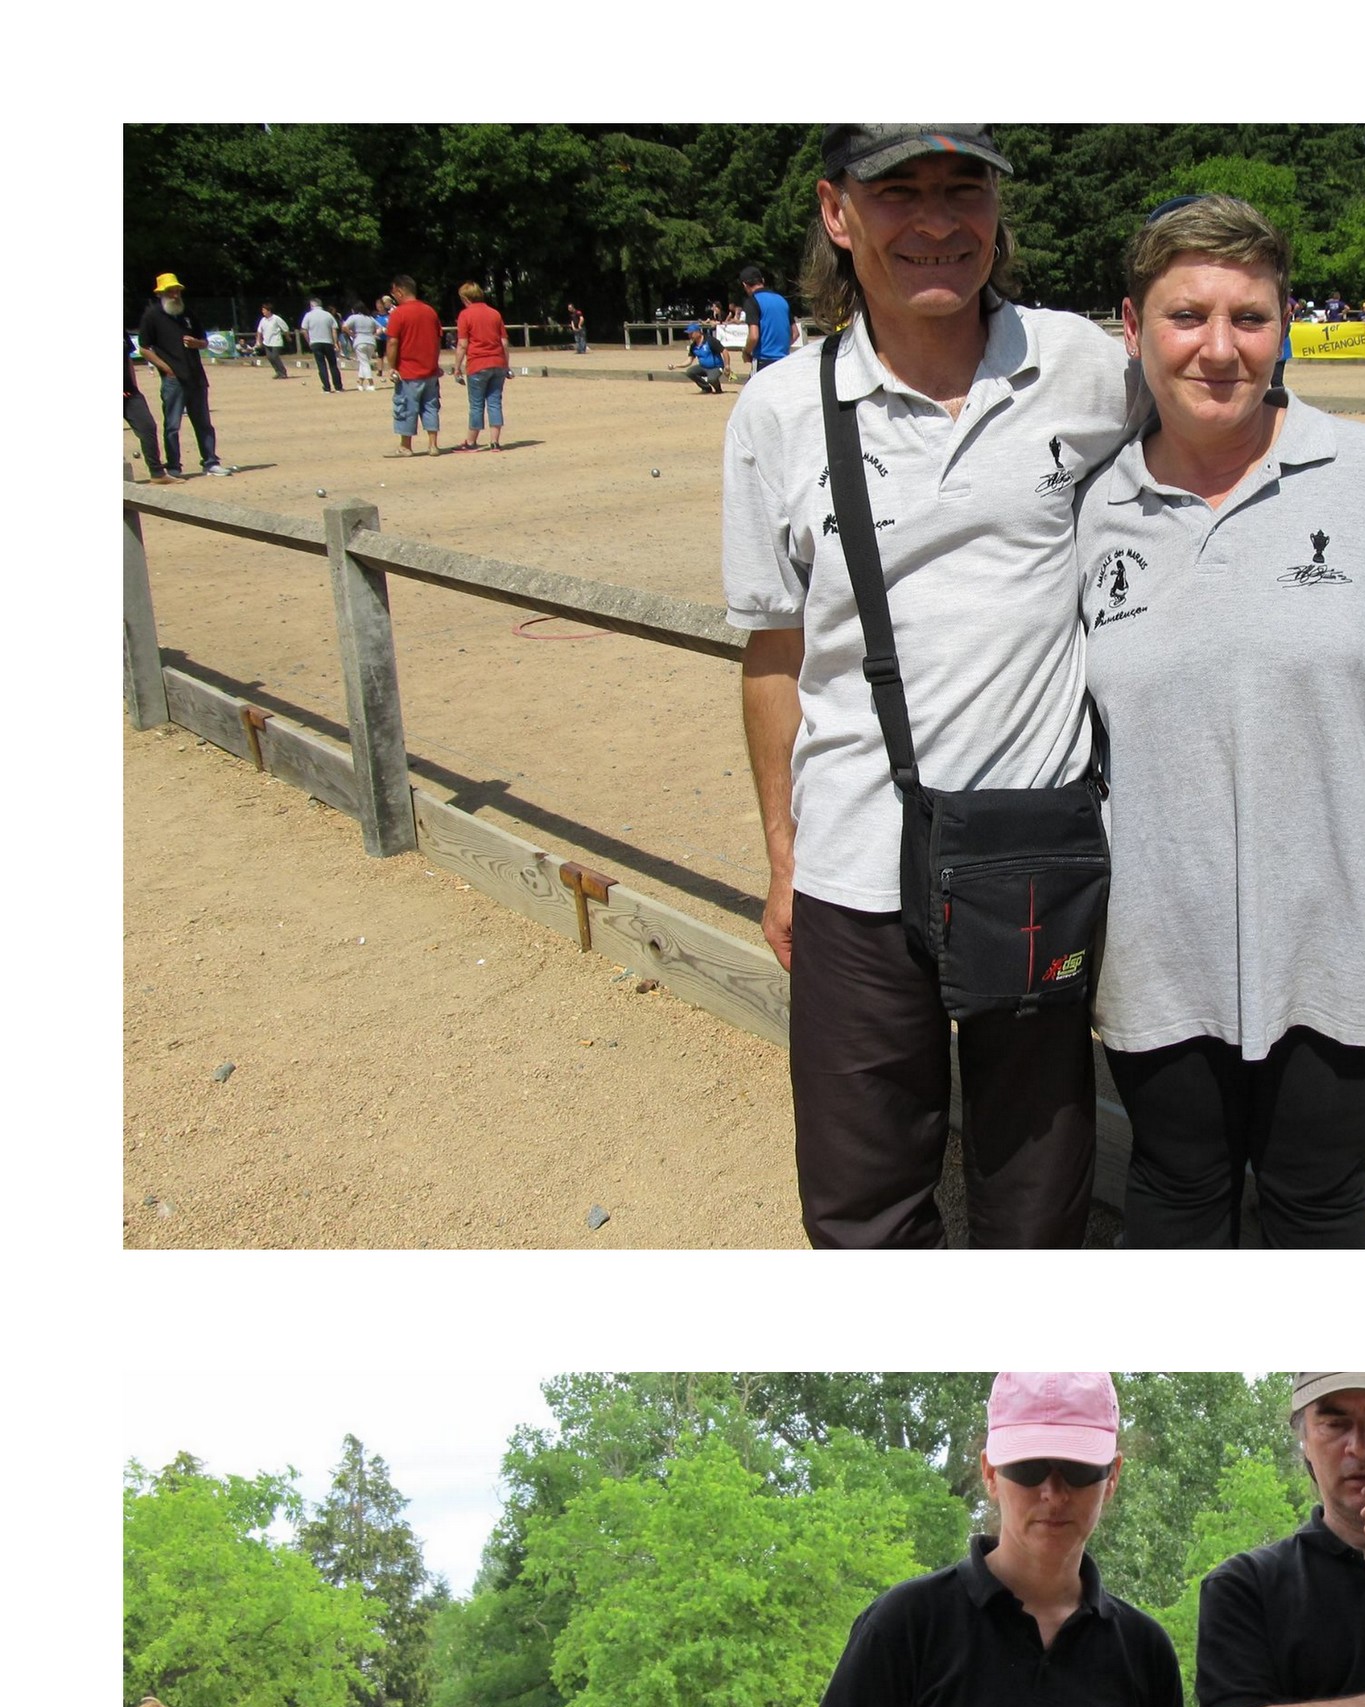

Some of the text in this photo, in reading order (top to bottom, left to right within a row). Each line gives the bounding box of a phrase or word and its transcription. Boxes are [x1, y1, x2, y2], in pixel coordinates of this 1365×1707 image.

[1322, 324, 1340, 341] 1er
[1302, 347, 1315, 357] EN
[818, 452, 889, 488] AMIC MARAIS
[1126, 548, 1148, 571] MARAIS
